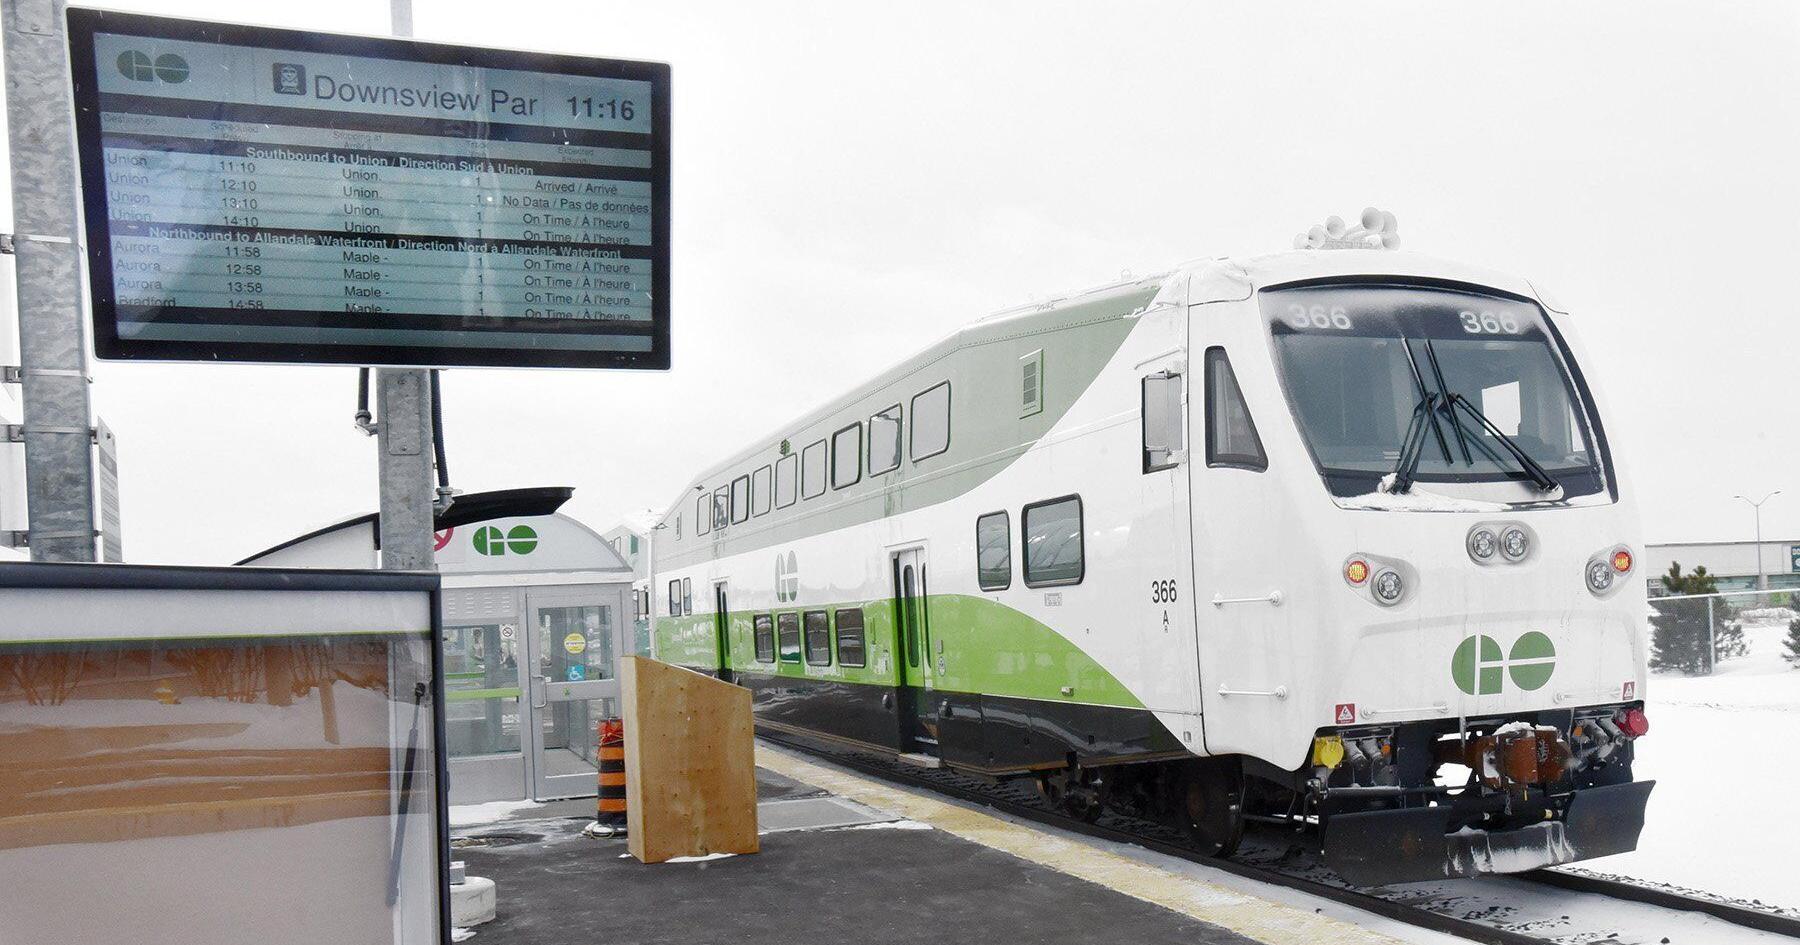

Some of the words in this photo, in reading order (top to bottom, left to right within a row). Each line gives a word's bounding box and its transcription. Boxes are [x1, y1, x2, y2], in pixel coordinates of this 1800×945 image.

[314, 75, 480, 111] Downsview
[491, 89, 538, 116] Par
[567, 96, 635, 121] 11:16
[107, 152, 147, 168] Union
[220, 161, 255, 173] 11:10
[342, 168, 382, 183] Union.
[476, 177, 482, 187] 1
[535, 180, 575, 193] Arrived
[585, 182, 618, 195] Arrivé
[247, 147, 328, 162] Southbound
[333, 153, 346, 164] to
[350, 154, 388, 167] Union
[399, 156, 456, 171] Direction
[459, 160, 484, 173] Sud
[488, 162, 495, 173] à
[498, 163, 534, 176] Union
[108, 171, 149, 185] Union
[221, 179, 256, 192] 12:10
[343, 186, 383, 200] Union.
[477, 194, 482, 204] 1
[503, 195, 520, 207] No
[523, 195, 550, 208] Data
[560, 199, 582, 211] Pas
[585, 199, 599, 212] de
[602, 200, 649, 214] données
[110, 190, 150, 204] Union
[222, 198, 258, 210] 13:10
[344, 204, 384, 217] Union.
[477, 212, 482, 221] 1
[522, 213, 541, 226] On
[544, 214, 571, 227] Time
[593, 216, 630, 230] l'heure
[112, 209, 150, 222] Union
[224, 216, 259, 228] 14:10
[523, 230, 541, 242] On
[544, 231, 571, 244] Time
[594, 234, 630, 246] l'heure
[150, 227, 232, 241] Northbound
[237, 231, 249, 244] to
[254, 233, 315, 246] Allandale
[319, 236, 387, 249] Waterfront
[399, 239, 454, 252] Direction
[458, 242, 487, 253] Nord
[491, 243, 498, 254] à
[502, 243, 555, 256] Allandale
[560, 246, 621, 259] Waterfront
[114, 241, 159, 254] Aurora
[225, 246, 261, 258] 11:58
[524, 259, 541, 270] On
[544, 260, 571, 272] Time
[594, 261, 630, 274] l'heure
[116, 259, 161, 272] Aurora
[226, 264, 261, 276] 12:58
[524, 275, 541, 287] On
[546, 277, 571, 288] Time
[594, 278, 631, 290] l'heure
[117, 278, 162, 290] Aurora
[228, 282, 263, 293] 13:58
[524, 292, 541, 304] On
[546, 293, 571, 305] Time
[594, 295, 631, 307] l'heure
[229, 300, 264, 310] 14:58
[525, 309, 542, 319] On
[546, 310, 572, 320] Time
[594, 312, 631, 321] l'heure
[1289, 304, 1351, 330] 366
[1459, 310, 1520, 334] 366
[1152, 579, 1177, 603] 366
[1163, 610, 1170, 625] A
